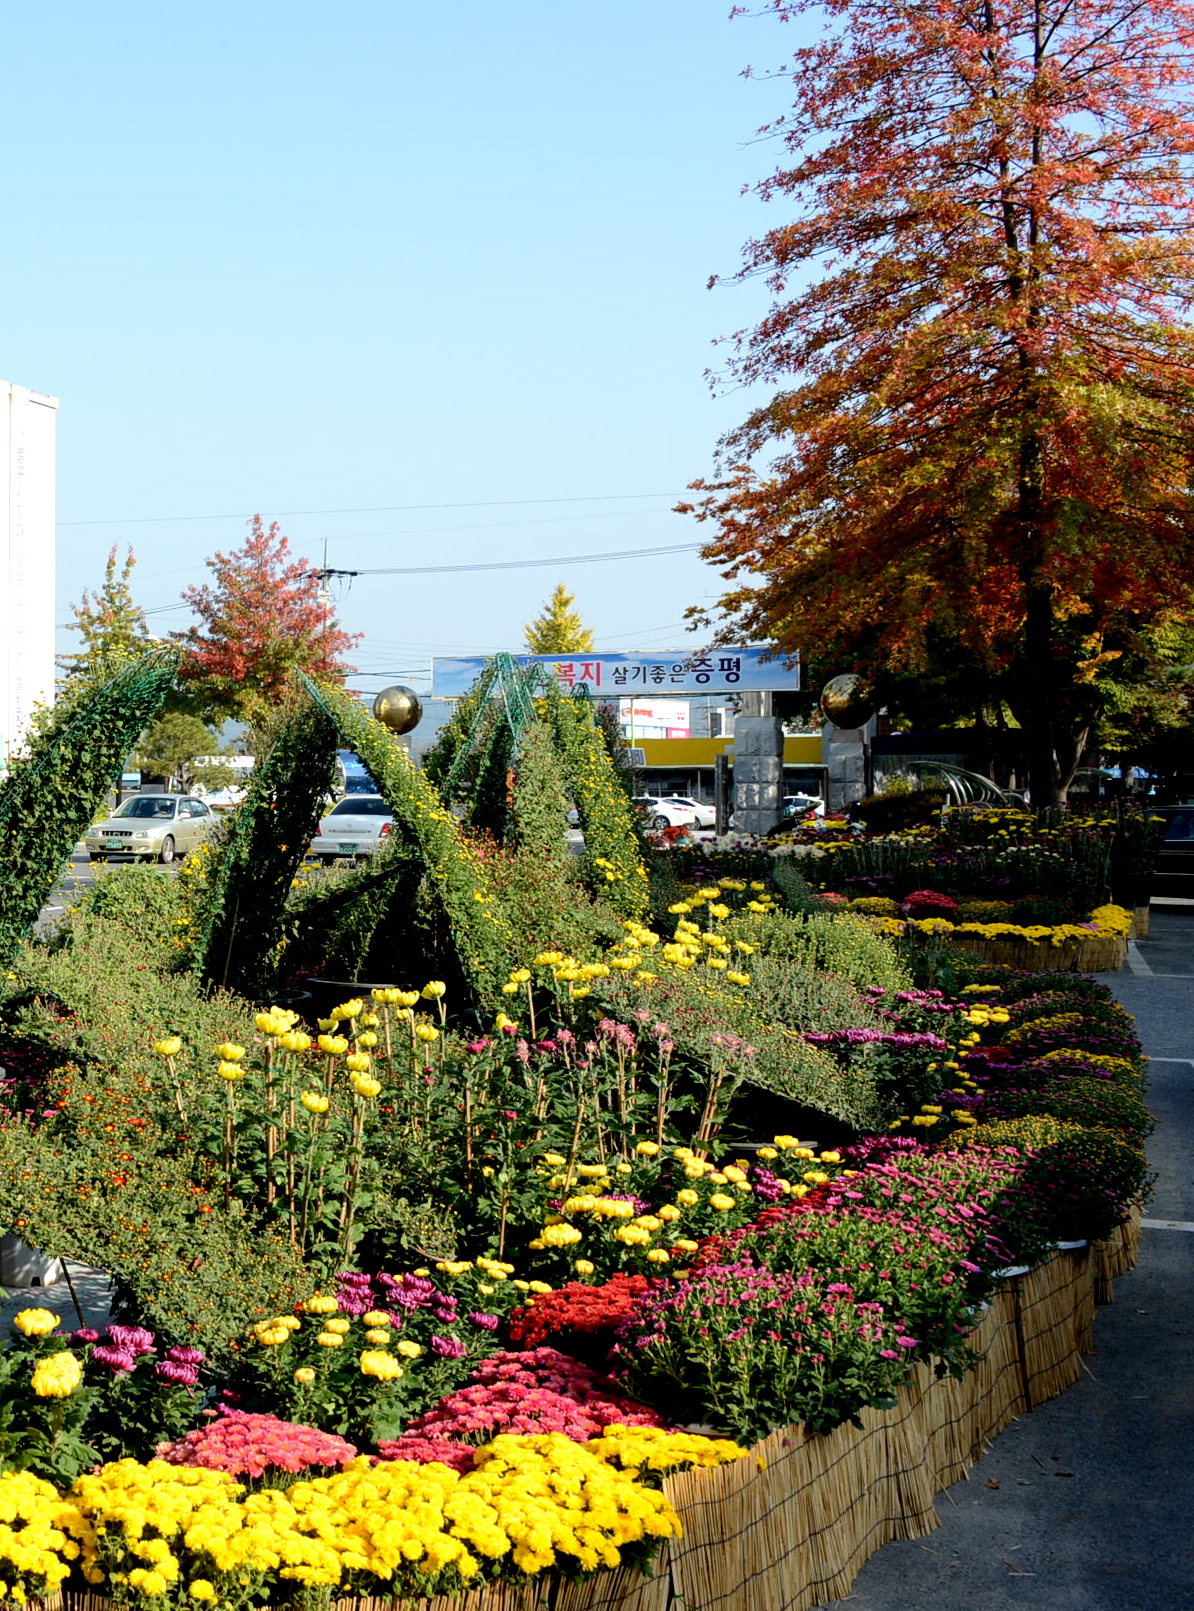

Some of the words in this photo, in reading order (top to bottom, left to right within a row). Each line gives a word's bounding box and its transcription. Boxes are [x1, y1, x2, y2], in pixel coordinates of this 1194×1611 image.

[556, 660, 602, 687] 복지
[612, 664, 686, 685] 살기좋은
[690, 657, 742, 684] 증평
